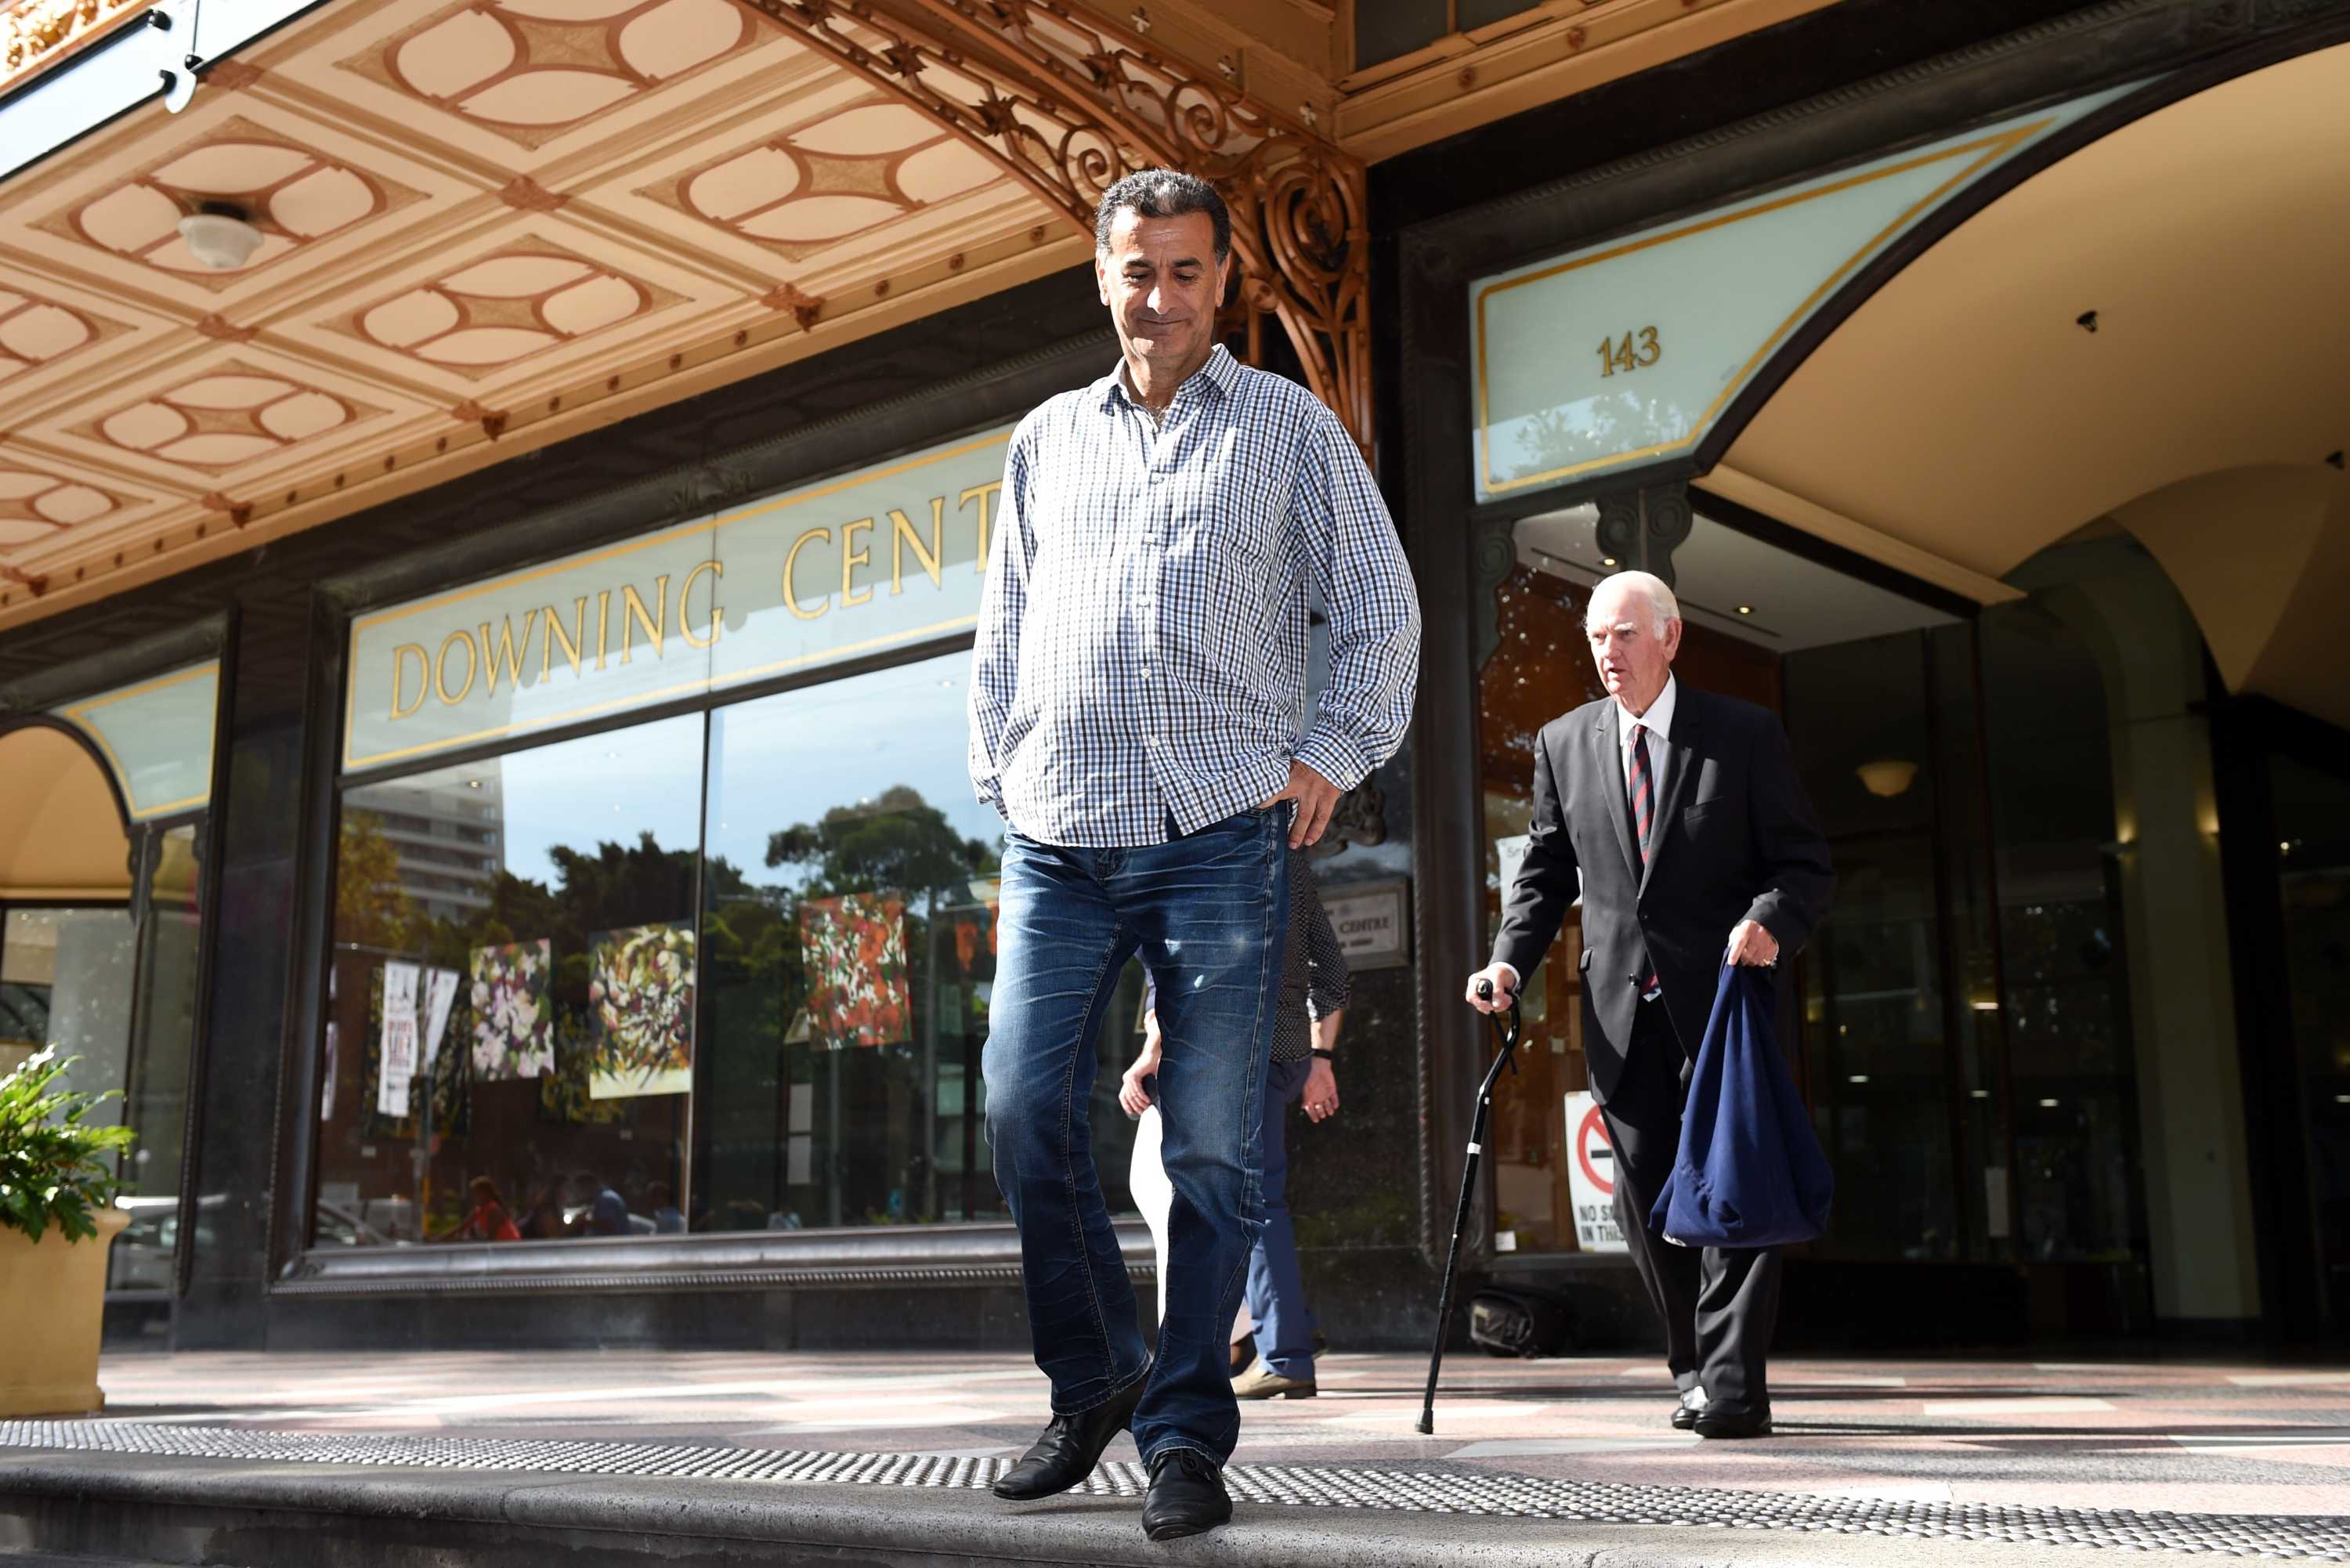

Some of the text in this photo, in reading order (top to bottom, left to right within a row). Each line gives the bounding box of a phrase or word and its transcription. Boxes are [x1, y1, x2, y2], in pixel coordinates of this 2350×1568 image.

[1596, 325, 1661, 378] 143
[389, 479, 1003, 721] DOWNING CENT
[1579, 1204, 1596, 1222] NO
[1581, 1224, 1625, 1242] IN THI
